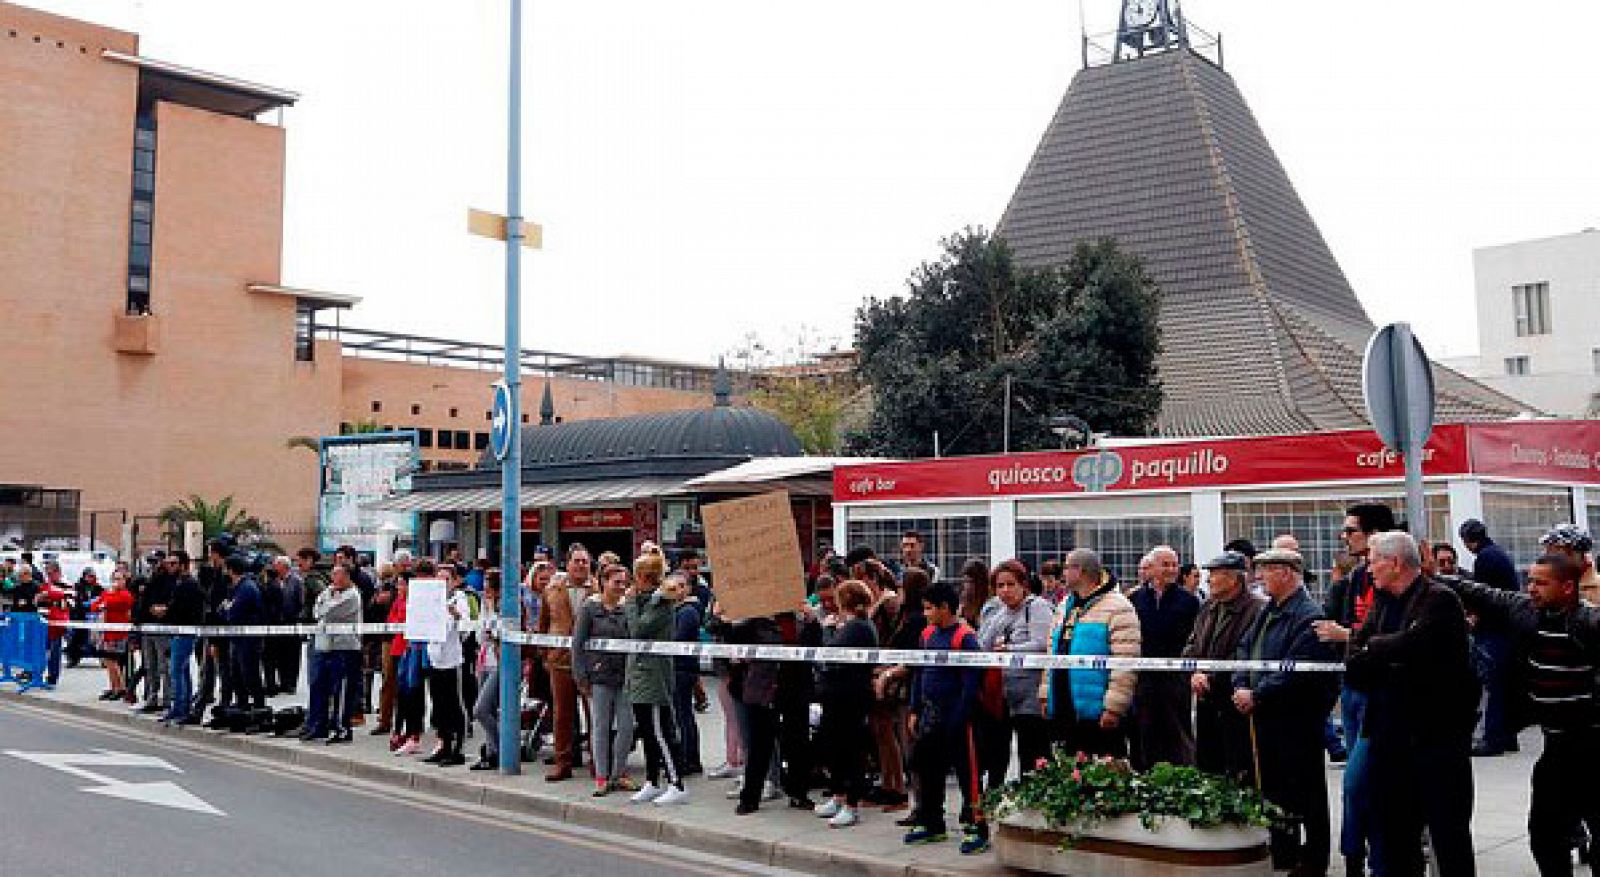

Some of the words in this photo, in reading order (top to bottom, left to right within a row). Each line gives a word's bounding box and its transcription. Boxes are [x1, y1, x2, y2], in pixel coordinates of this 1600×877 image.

[988, 462, 1066, 491] quiosco
[1130, 448, 1228, 484] paquillo
[876, 478, 895, 490] bar
